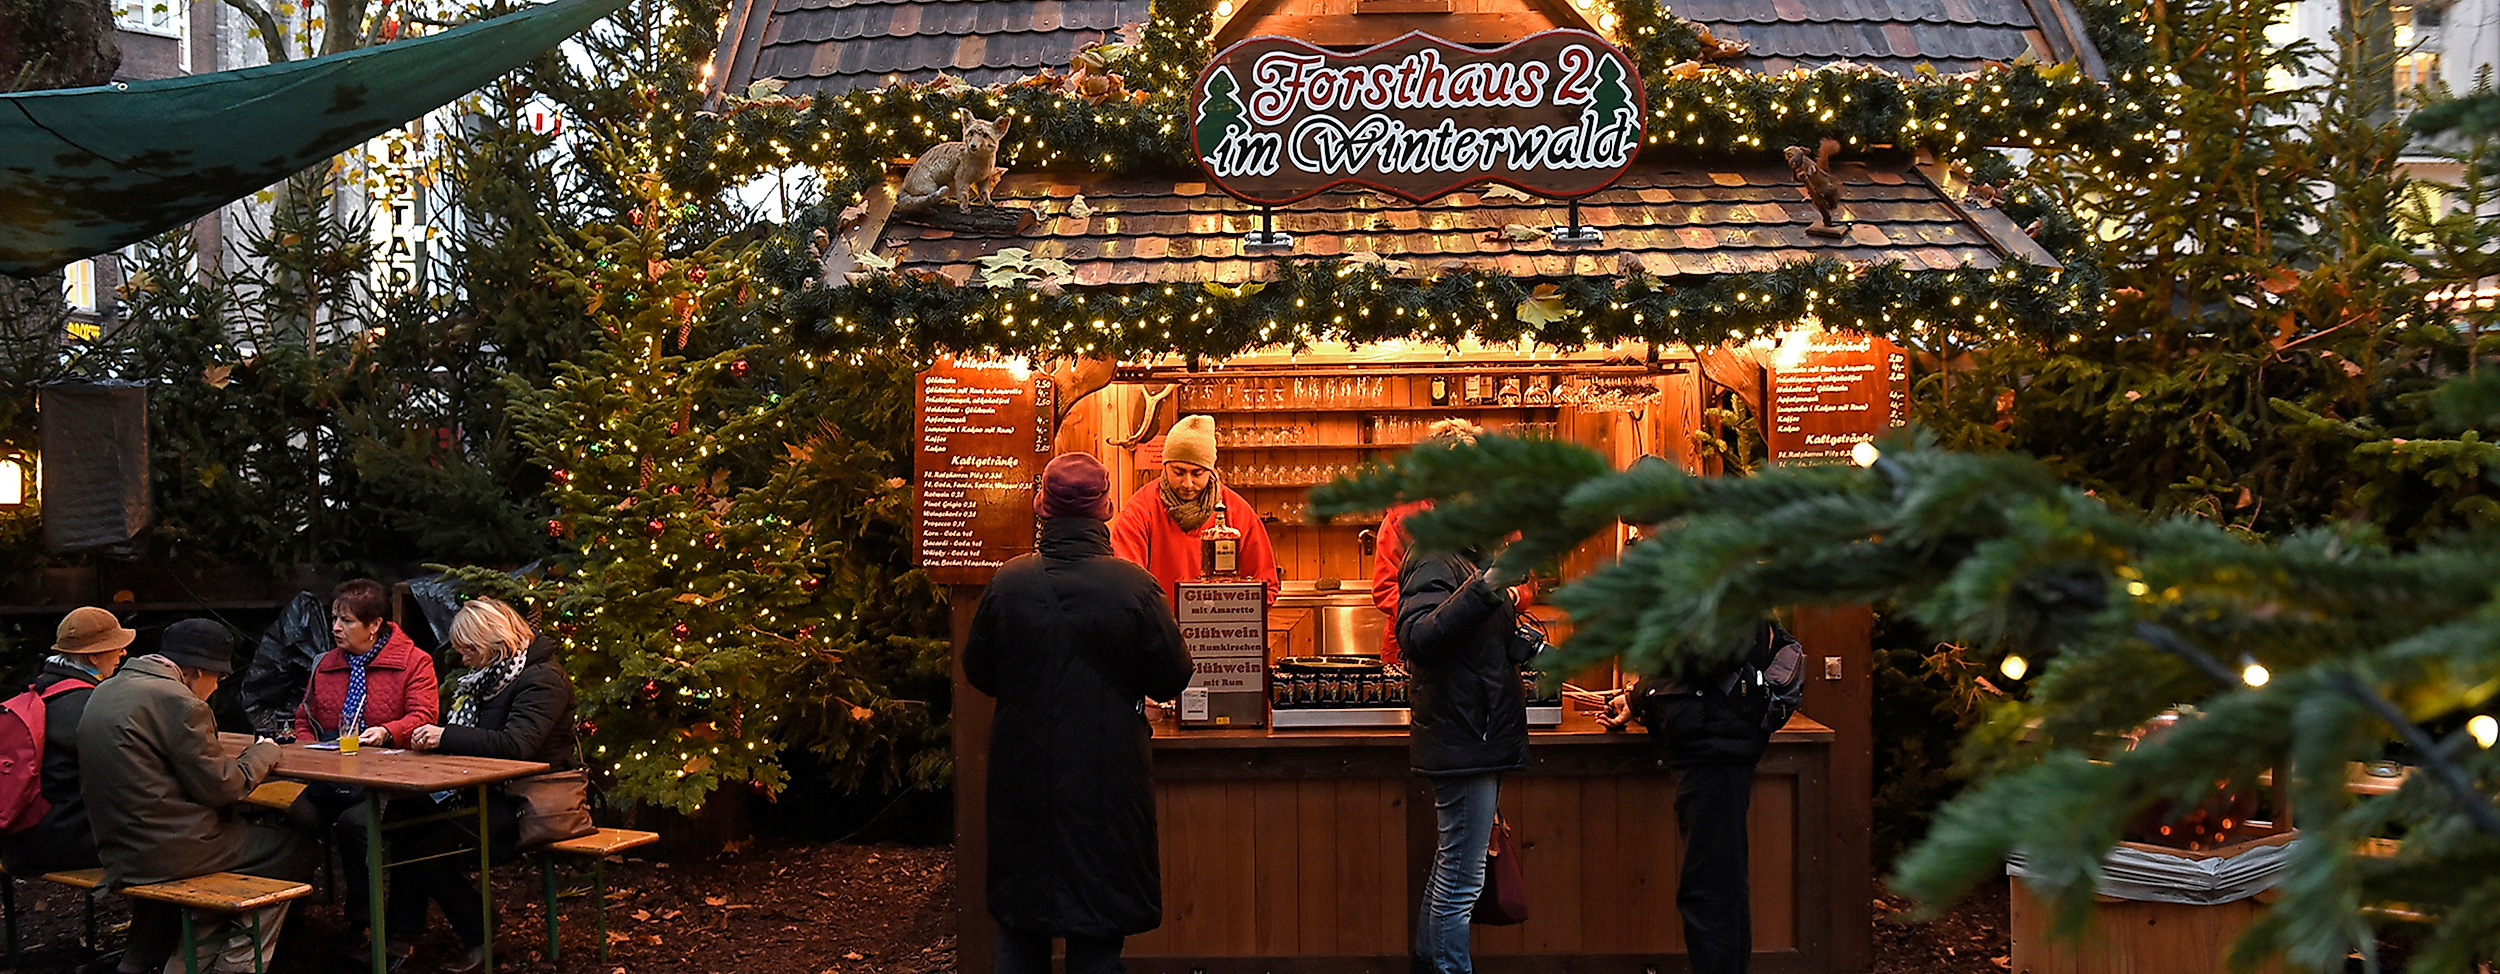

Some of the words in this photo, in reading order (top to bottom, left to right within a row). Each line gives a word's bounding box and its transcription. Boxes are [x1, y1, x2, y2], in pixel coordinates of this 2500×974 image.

[1253, 51, 1545, 121] Forsthaus
[1558, 47, 1590, 100] 2
[1216, 124, 1276, 173] im
[1291, 112, 1627, 171] Winterwald
[924, 435, 947, 443] Kaffee
[1805, 433, 1874, 446] Kaltgetränke
[951, 455, 1018, 467] Kaltgetränke
[923, 500, 941, 508] Pinot
[942, 501, 962, 509] Grigio
[923, 520, 951, 528] Prosecco
[923, 549, 946, 557] Whisky
[963, 560, 1004, 568] Flaschenpfa
[1184, 589, 1261, 601] Glühwein
[1191, 606, 1208, 614] mit
[1209, 606, 1255, 614] Amaretto
[1182, 627, 1259, 639] Glühwein
[1199, 643, 1262, 651] Rumkirschen
